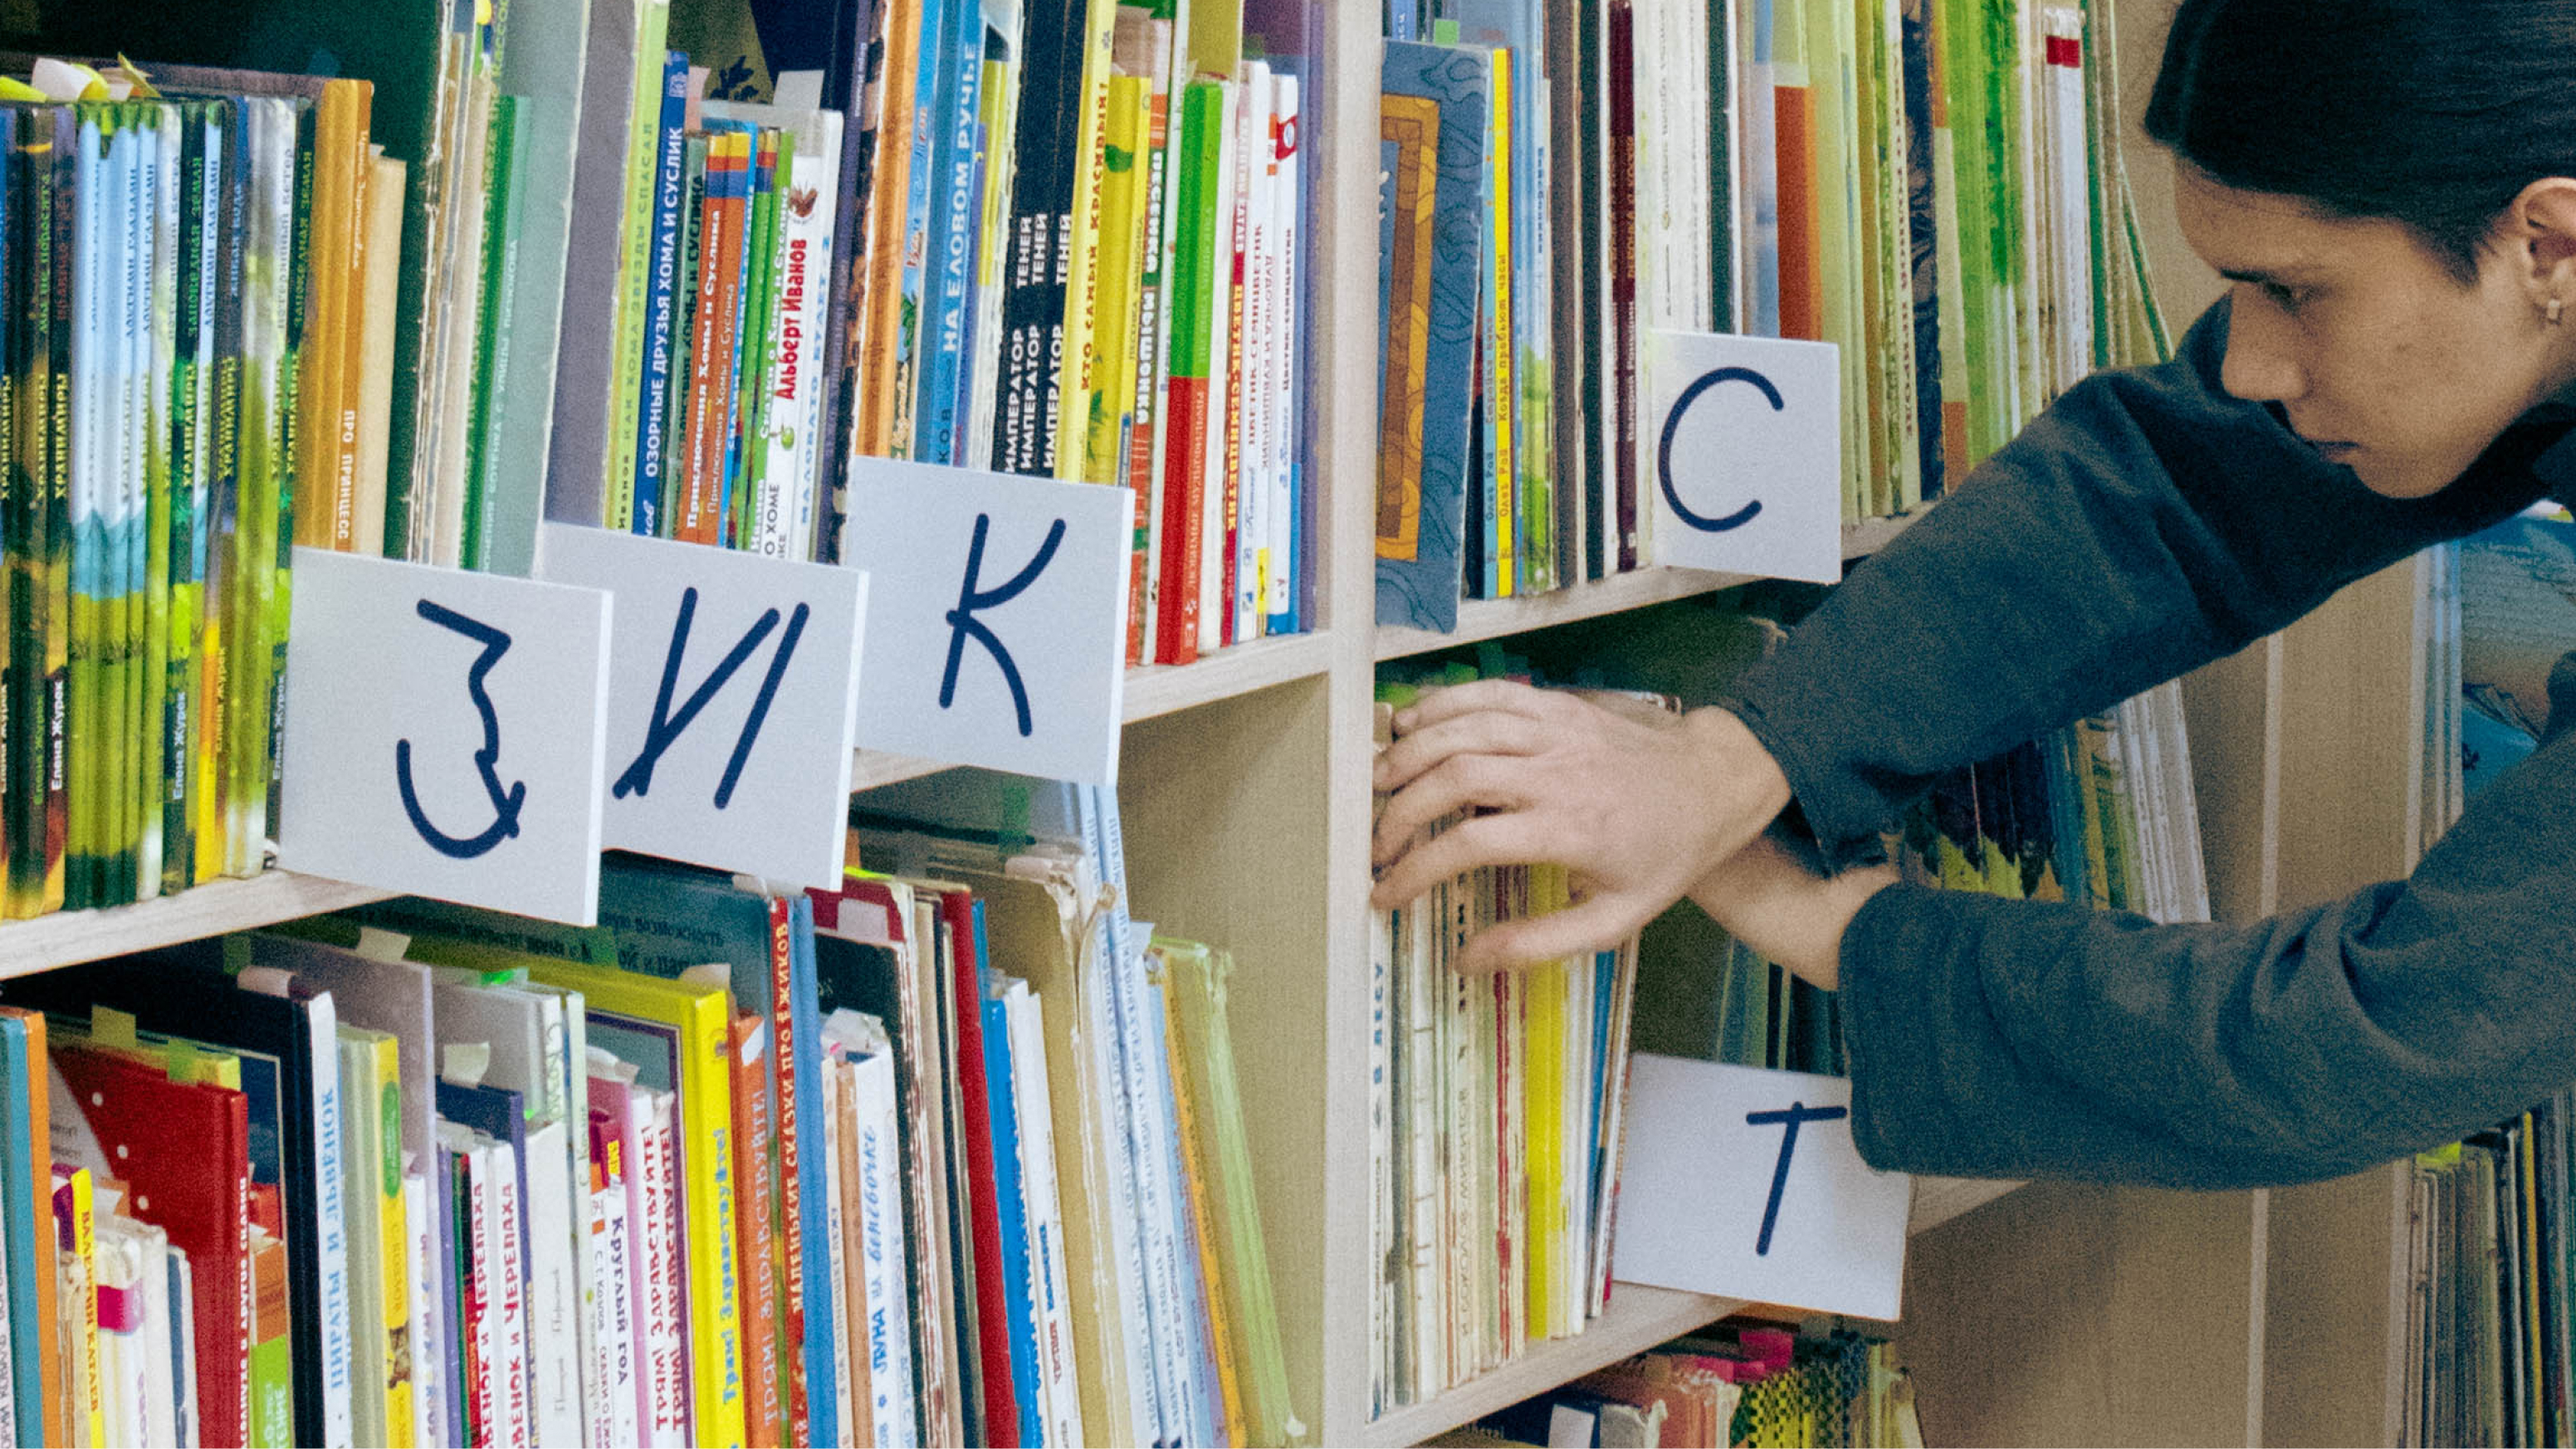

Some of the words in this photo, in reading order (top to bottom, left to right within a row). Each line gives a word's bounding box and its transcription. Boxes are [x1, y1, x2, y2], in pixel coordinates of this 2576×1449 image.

[957, 41, 976, 149] РУЧЬЕ
[638, 122, 652, 214] СПАСАЛ
[664, 127, 682, 208] СУСЛИК
[662, 213, 676, 227] И
[687, 175, 703, 262] СУСЛИКА
[703, 210, 720, 295] Суслика
[774, 186, 789, 269] Суслике
[946, 161, 969, 297] ЕЛОВОМ
[1146, 150, 1164, 273] ПЕСЕНКА
[631, 225, 645, 315] ЗВЕЗДЫ
[658, 232, 675, 290] ХОМА
[781, 238, 807, 312] Иванов
[1085, 245, 1097, 329] САМЫЙ
[652, 295, 670, 373] ДРУЗЬЯ
[698, 320, 711, 378] Хомы
[706, 303, 714, 315] и
[767, 292, 780, 342] Хоме
[943, 309, 960, 353] НА
[1004, 328, 1024, 472] ИМПЕРАТОР
[1015, 217, 1032, 289] ТЕНЕЙ
[1020, 324, 1040, 469] ИМПЕРАТОР
[1031, 213, 1048, 285] ТЕНЕЙ
[1044, 324, 1063, 468] ИМПЕРАТОР
[1055, 214, 1071, 285] ТЕНЕЙ
[1497, 299, 1508, 368] пробьют
[627, 324, 638, 386] ХОМА
[715, 363, 728, 405] Хомы
[775, 317, 803, 400] Альберт
[1081, 343, 1092, 390] КТО
[1137, 291, 1155, 425] МЫШОНКА
[2, 375, 11, 500] ХРАНИМИРЫ
[37, 374, 46, 498] ХРАНИМИРЫ
[56, 373, 66, 498] ХРАНИМИРЫ
[183, 363, 196, 488] ХРАНИМИРЫ
[224, 356, 236, 476] ХРАНИМИРЫ
[286, 352, 299, 474] ХРАНИМИРЫ
[343, 410, 356, 444] ПРО
[623, 398, 633, 440] КАК
[645, 378, 664, 477] ОЗОРНЫЕ
[760, 366, 775, 439] Сказки
[687, 383, 707, 528] Приключения
[707, 412, 724, 514] Приключения
[800, 377, 819, 524] МАЛОВАТО
[1498, 448, 1508, 475] Рой
[1658, 366, 1784, 533] С
[338, 453, 354, 540] ПРИНЦЕСС
[765, 484, 780, 534] ХОМЕ
[1498, 483, 1508, 517] Олег
[764, 541, 775, 555] О
[939, 513, 1066, 737] К
[51, 681, 64, 735] Журек
[174, 692, 186, 745] Журек
[612, 587, 809, 809] И
[51, 739, 62, 790] Елена
[173, 749, 184, 799] Елена
[1373, 962, 1383, 1046] ЛЕСУ
[780, 1030, 794, 1071] ПРО
[783, 1080, 797, 1168] СКАЗКИ
[750, 1090, 775, 1319] ЗДРАВСТВУЙТЕ!
[1745, 1100, 1850, 1256] Т
[326, 1232, 340, 1252] И
[473, 1182, 489, 1325] ЧЕРЕПАХА
[502, 1182, 519, 1325] ЧЕРЕПАХА
[641, 1125, 662, 1337] ЗДРАВСТВУЙТЕ!
[659, 1126, 680, 1338] ЗДРАВСТВУЙТЕ!
[712, 1127, 735, 1321] Здравствуйте!
[786, 1177, 804, 1314] МАЛЕНЬКИЕ
[81, 1211, 94, 1325] ВАЛЕНТИН
[611, 1215, 628, 1333] Круглый
[833, 1258, 845, 1353] СОЛНЫШКЕ
[87, 1331, 98, 1412] КАТАЕВ
[327, 1271, 344, 1389] ПИРАТЫ
[617, 1341, 628, 1386] год
[720, 1328, 739, 1405] Трям!
[872, 1307, 887, 1374] ЛУНА
[651, 1348, 667, 1432] ТРЯМ!
[669, 1348, 686, 1432] ТРЯМ!
[761, 1333, 778, 1427] ТРЯМ!
